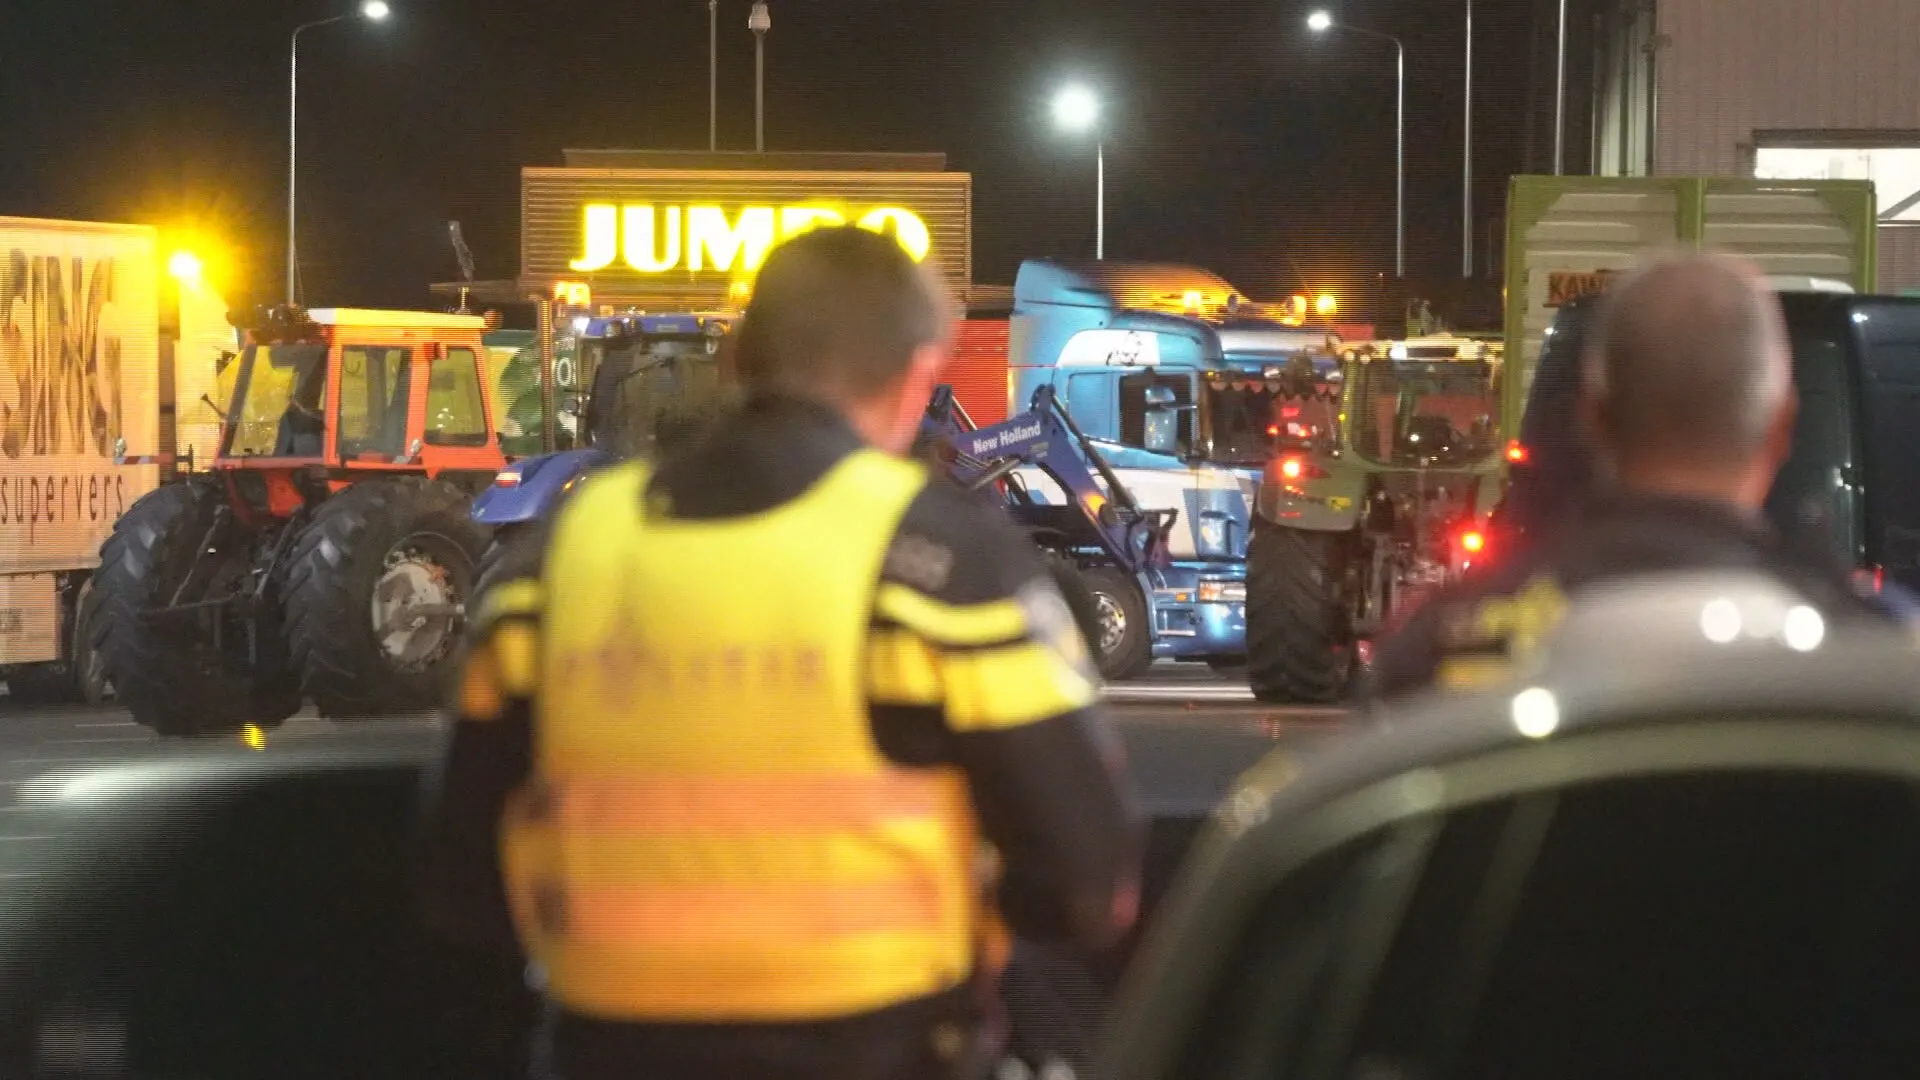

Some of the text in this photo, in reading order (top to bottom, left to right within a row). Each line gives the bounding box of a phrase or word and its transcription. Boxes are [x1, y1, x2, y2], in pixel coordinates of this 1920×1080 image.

[1549, 272, 1607, 304] KAW
[972, 421, 1041, 455] New Holland
[1, 473, 124, 545] supervers
